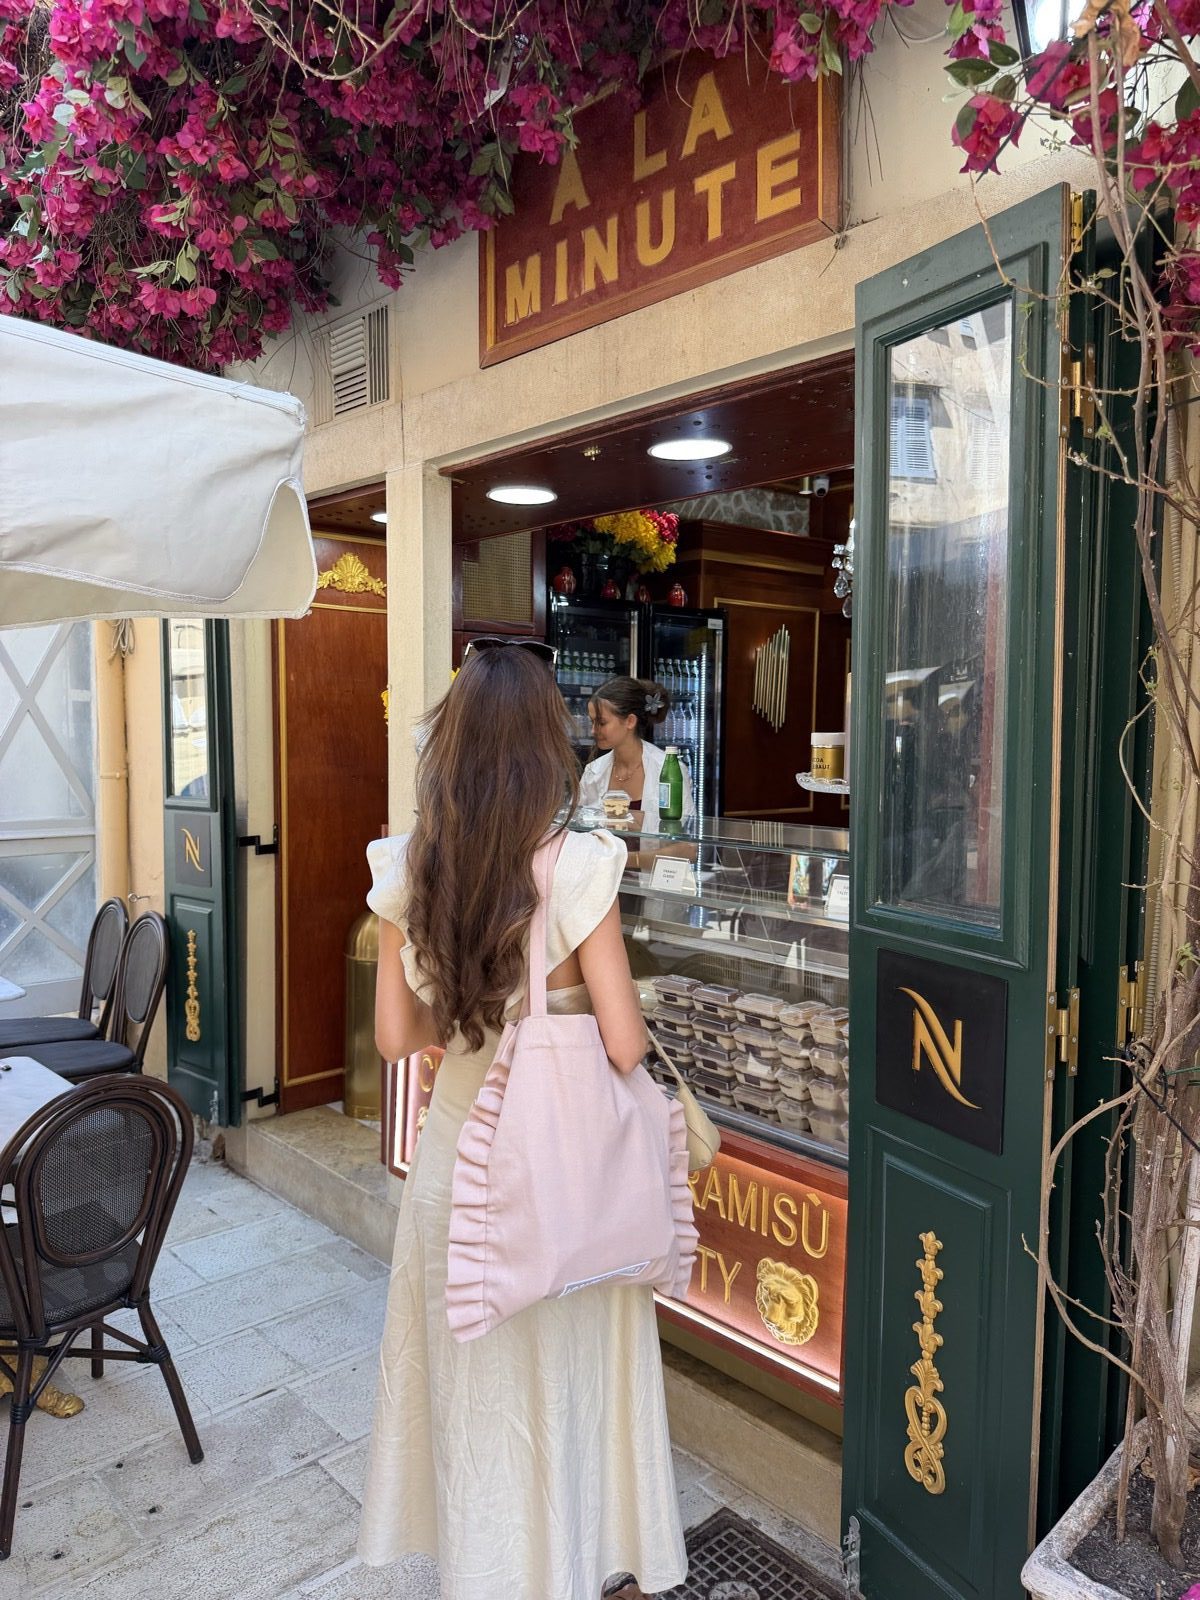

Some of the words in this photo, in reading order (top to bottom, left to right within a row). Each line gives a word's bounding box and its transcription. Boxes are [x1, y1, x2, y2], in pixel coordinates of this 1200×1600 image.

[633, 71, 734, 182] LA
[504, 130, 801, 327] MINUTE
[896, 987, 983, 1110] N
